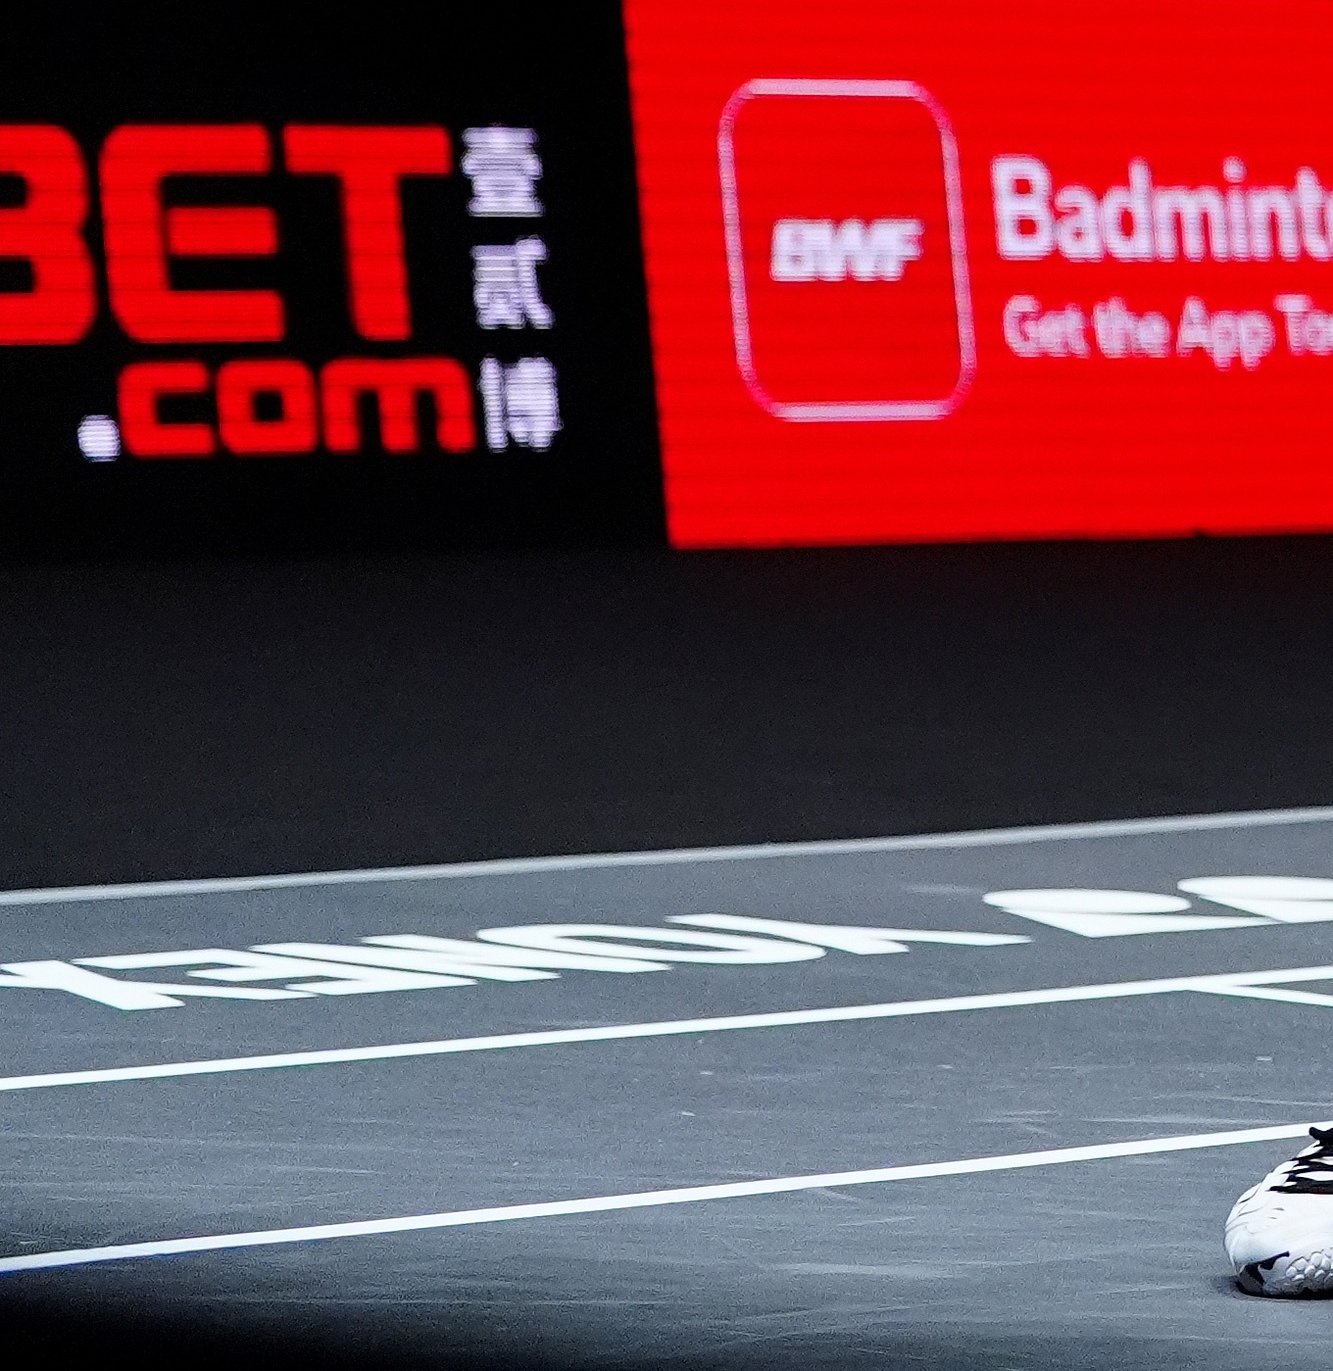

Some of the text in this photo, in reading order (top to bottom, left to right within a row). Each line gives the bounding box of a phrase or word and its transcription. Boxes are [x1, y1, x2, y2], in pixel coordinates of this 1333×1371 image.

[0, 126, 450, 345] BET
[772, 220, 921, 281] BWF
[1005, 297, 1086, 357] Get
[1095, 301, 1169, 358] the
[1179, 301, 1272, 367] App
[77, 359, 475, 461] .com
